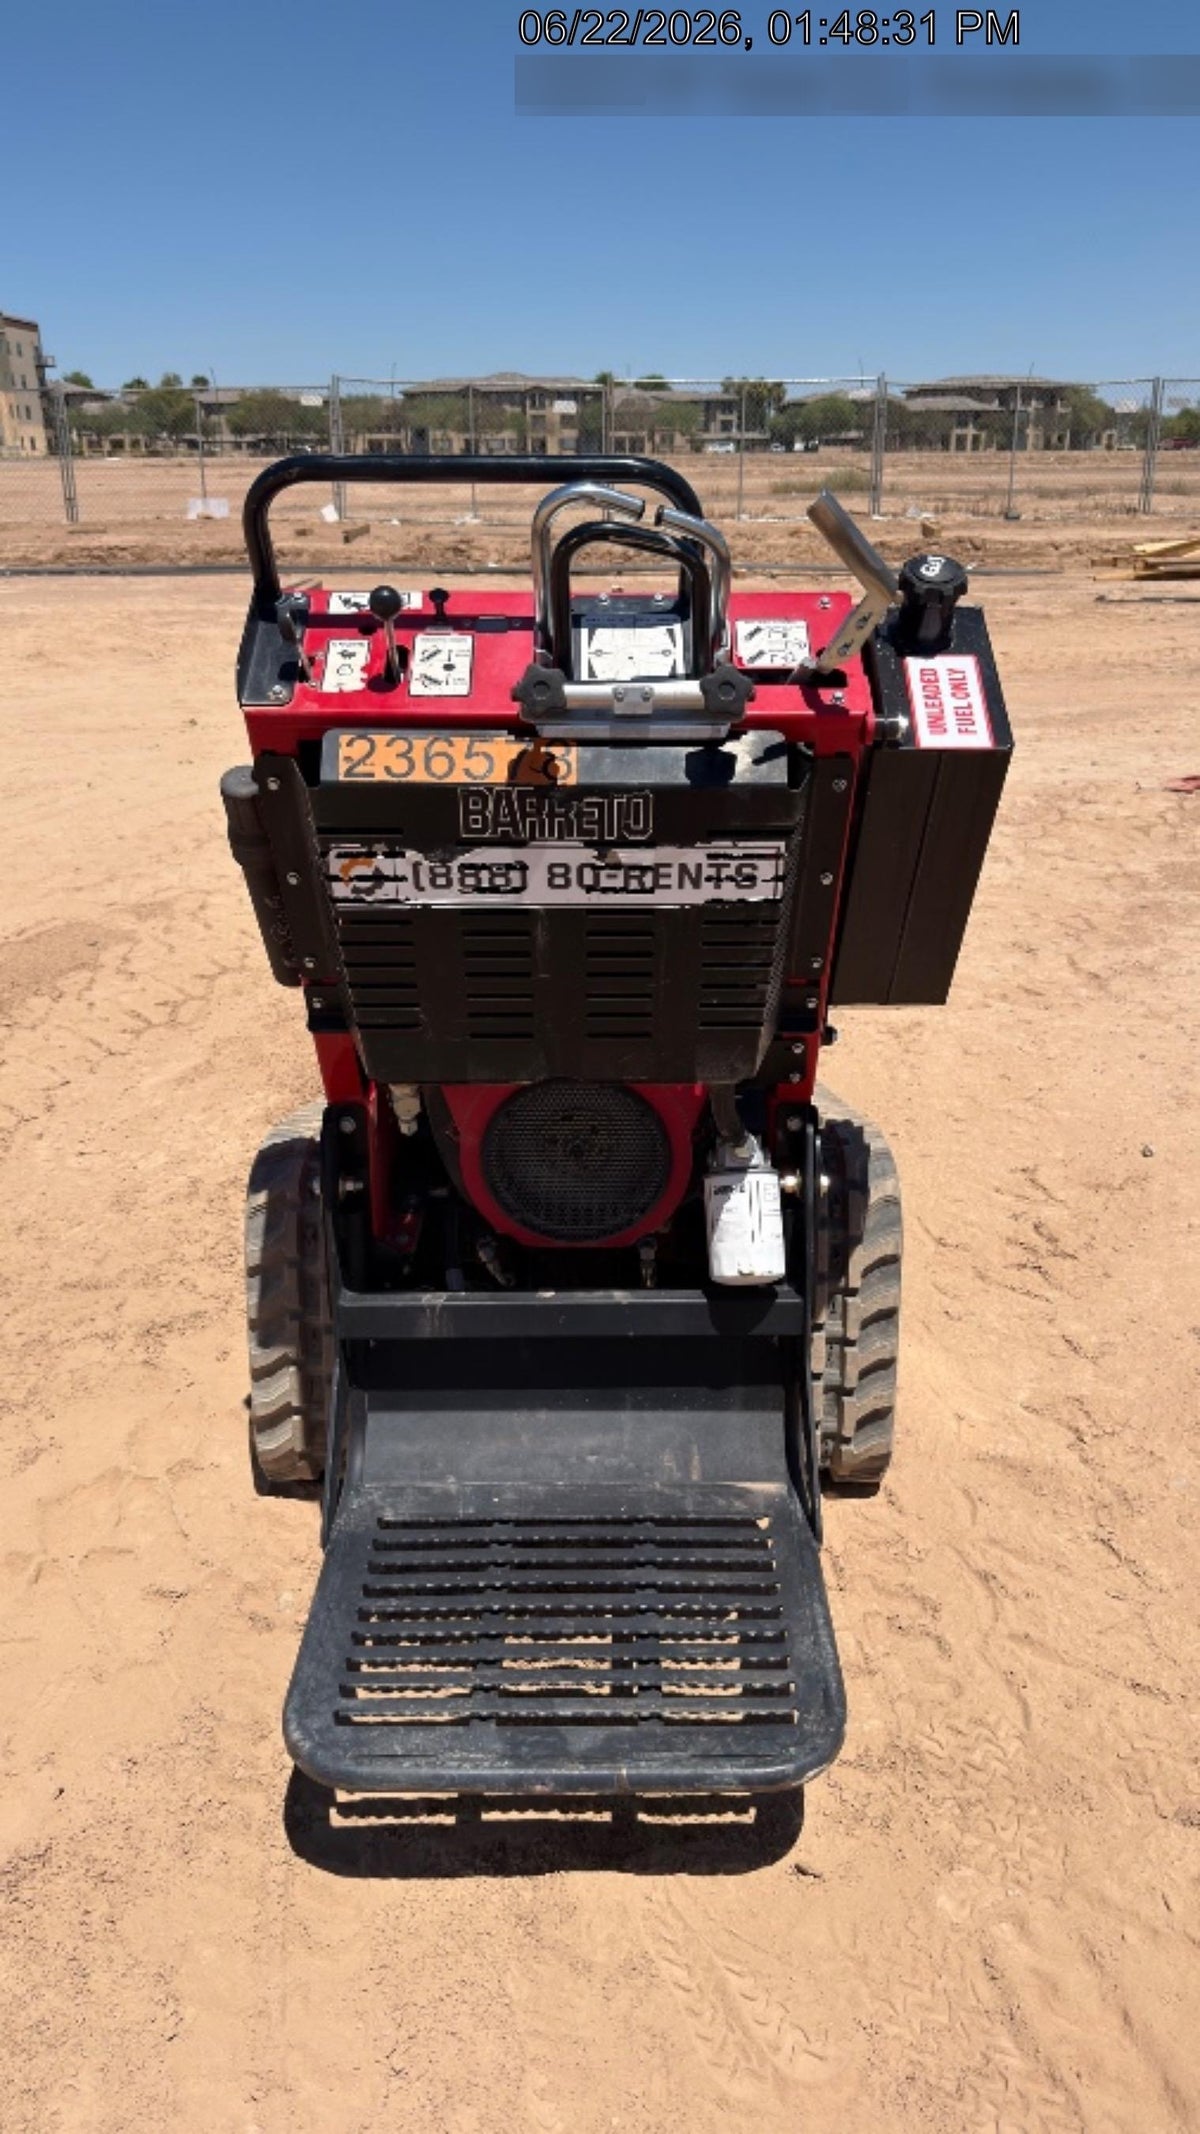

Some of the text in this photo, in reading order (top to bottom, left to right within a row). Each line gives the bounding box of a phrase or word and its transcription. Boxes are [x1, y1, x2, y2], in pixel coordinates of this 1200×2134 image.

[920, 668, 947, 735] UNLEADED
[948, 668, 977, 735] FUEL ONLY
[458, 787, 654, 840] BARRETO
[412, 861, 528, 893] (888)
